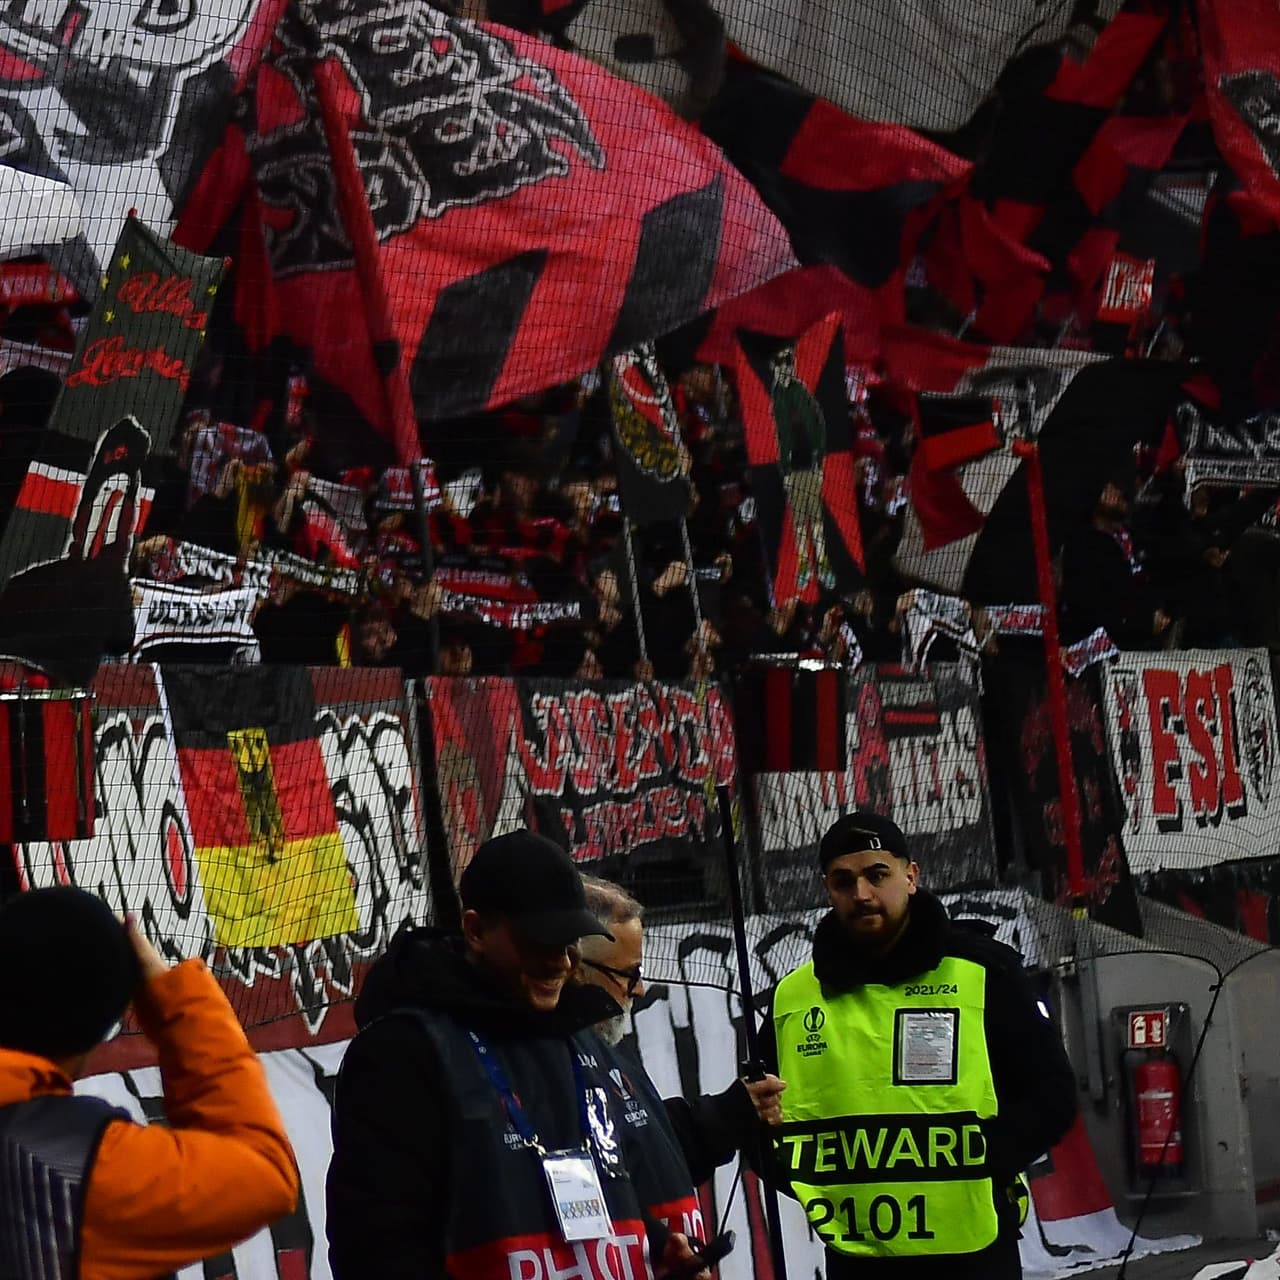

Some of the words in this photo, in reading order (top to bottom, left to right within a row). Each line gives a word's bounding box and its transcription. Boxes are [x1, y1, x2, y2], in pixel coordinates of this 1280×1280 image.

[904, 984, 958, 996] 2021/24
[771, 1123, 987, 1173] TEWARD
[805, 1193, 935, 1242] 2101
[506, 1233, 656, 1280] PHOT
